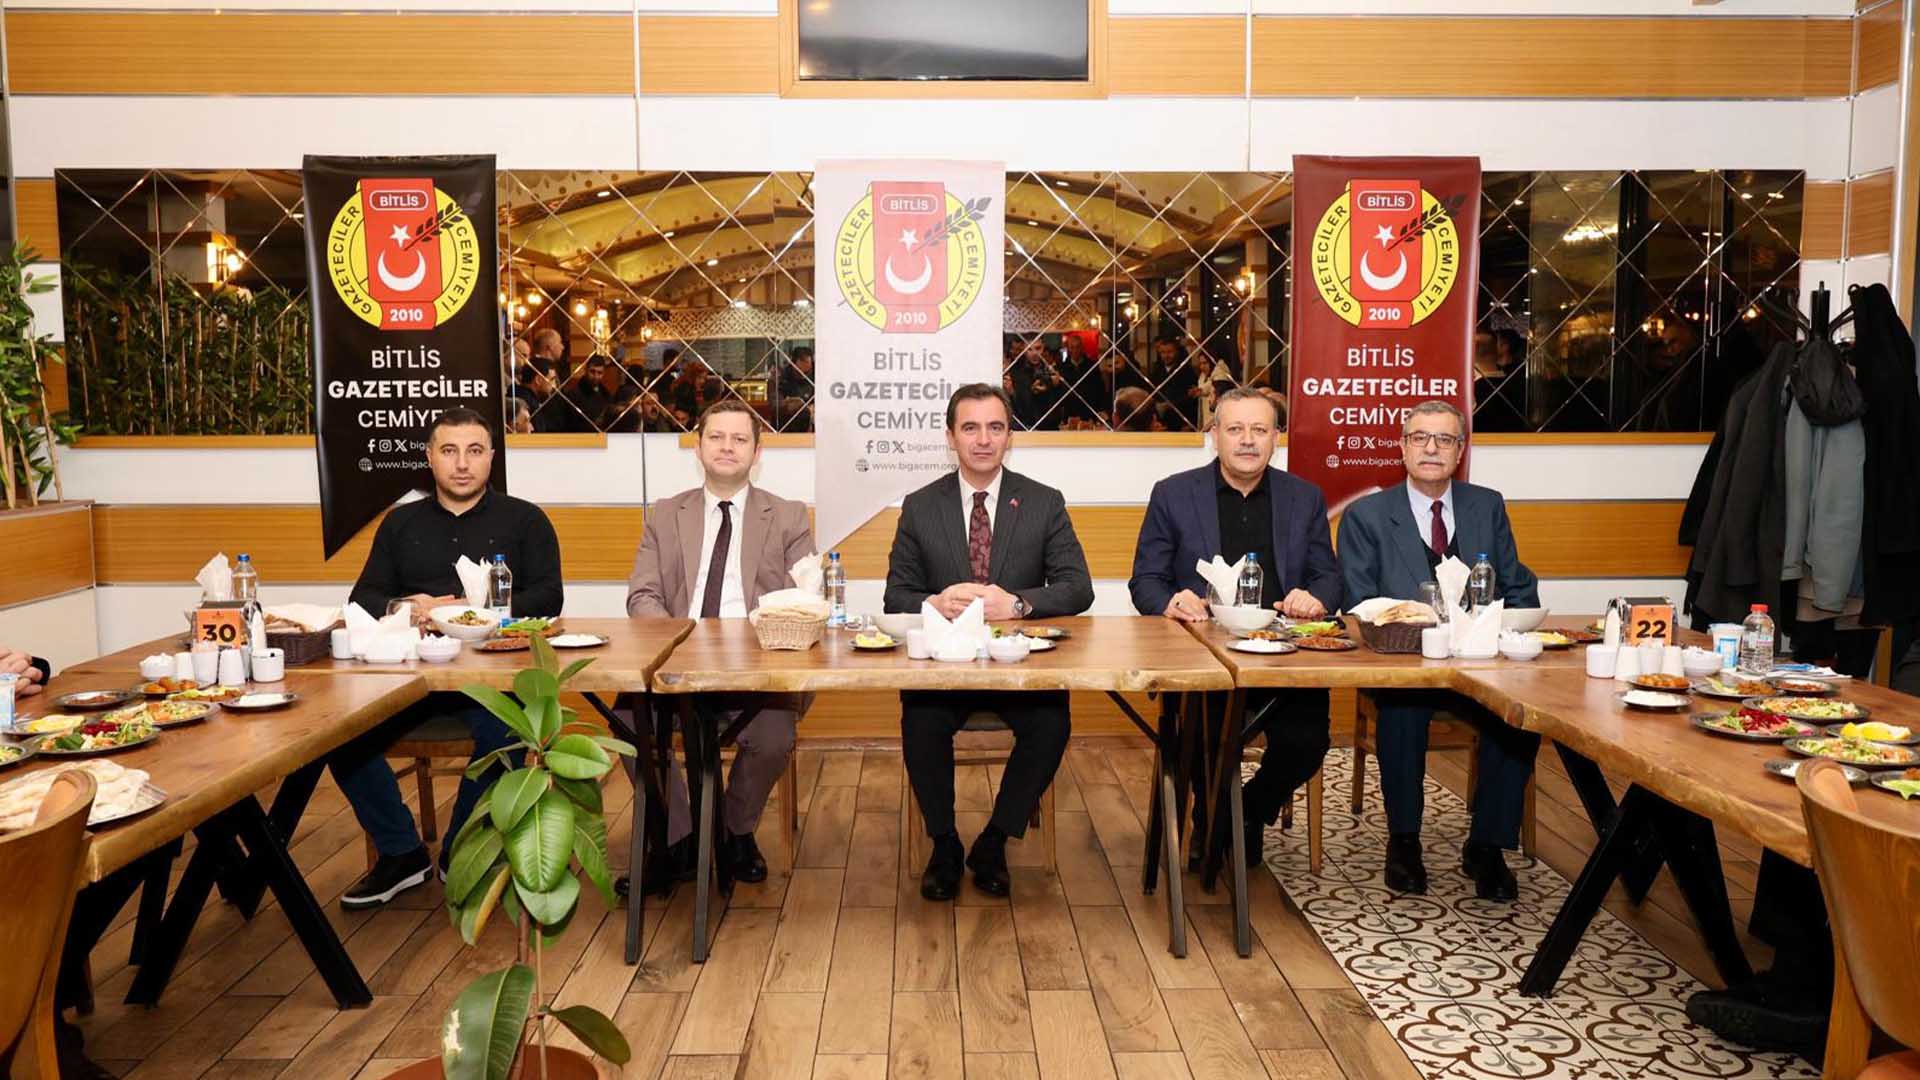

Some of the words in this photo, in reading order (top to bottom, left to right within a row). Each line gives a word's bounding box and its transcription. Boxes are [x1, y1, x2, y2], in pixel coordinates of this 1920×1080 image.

[379, 193, 419, 207] BİTLİS
[1367, 195, 1405, 208] BİTLİS
[390, 308, 423, 322] 2010
[895, 312, 927, 325] 2010
[1369, 308, 1401, 321] 2010
[371, 345, 441, 369] BİTLİS
[873, 347, 942, 371] BİTLİS
[1347, 344, 1415, 367] BİTLİS
[328, 375, 488, 399] GAZETECİLER
[1302, 374, 1458, 396] GAZETECİLER
[857, 407, 947, 430] CEMİYE
[1329, 403, 1412, 425] CEMİYE
[203, 623, 236, 643] 30
[1636, 619, 1667, 639] 22
